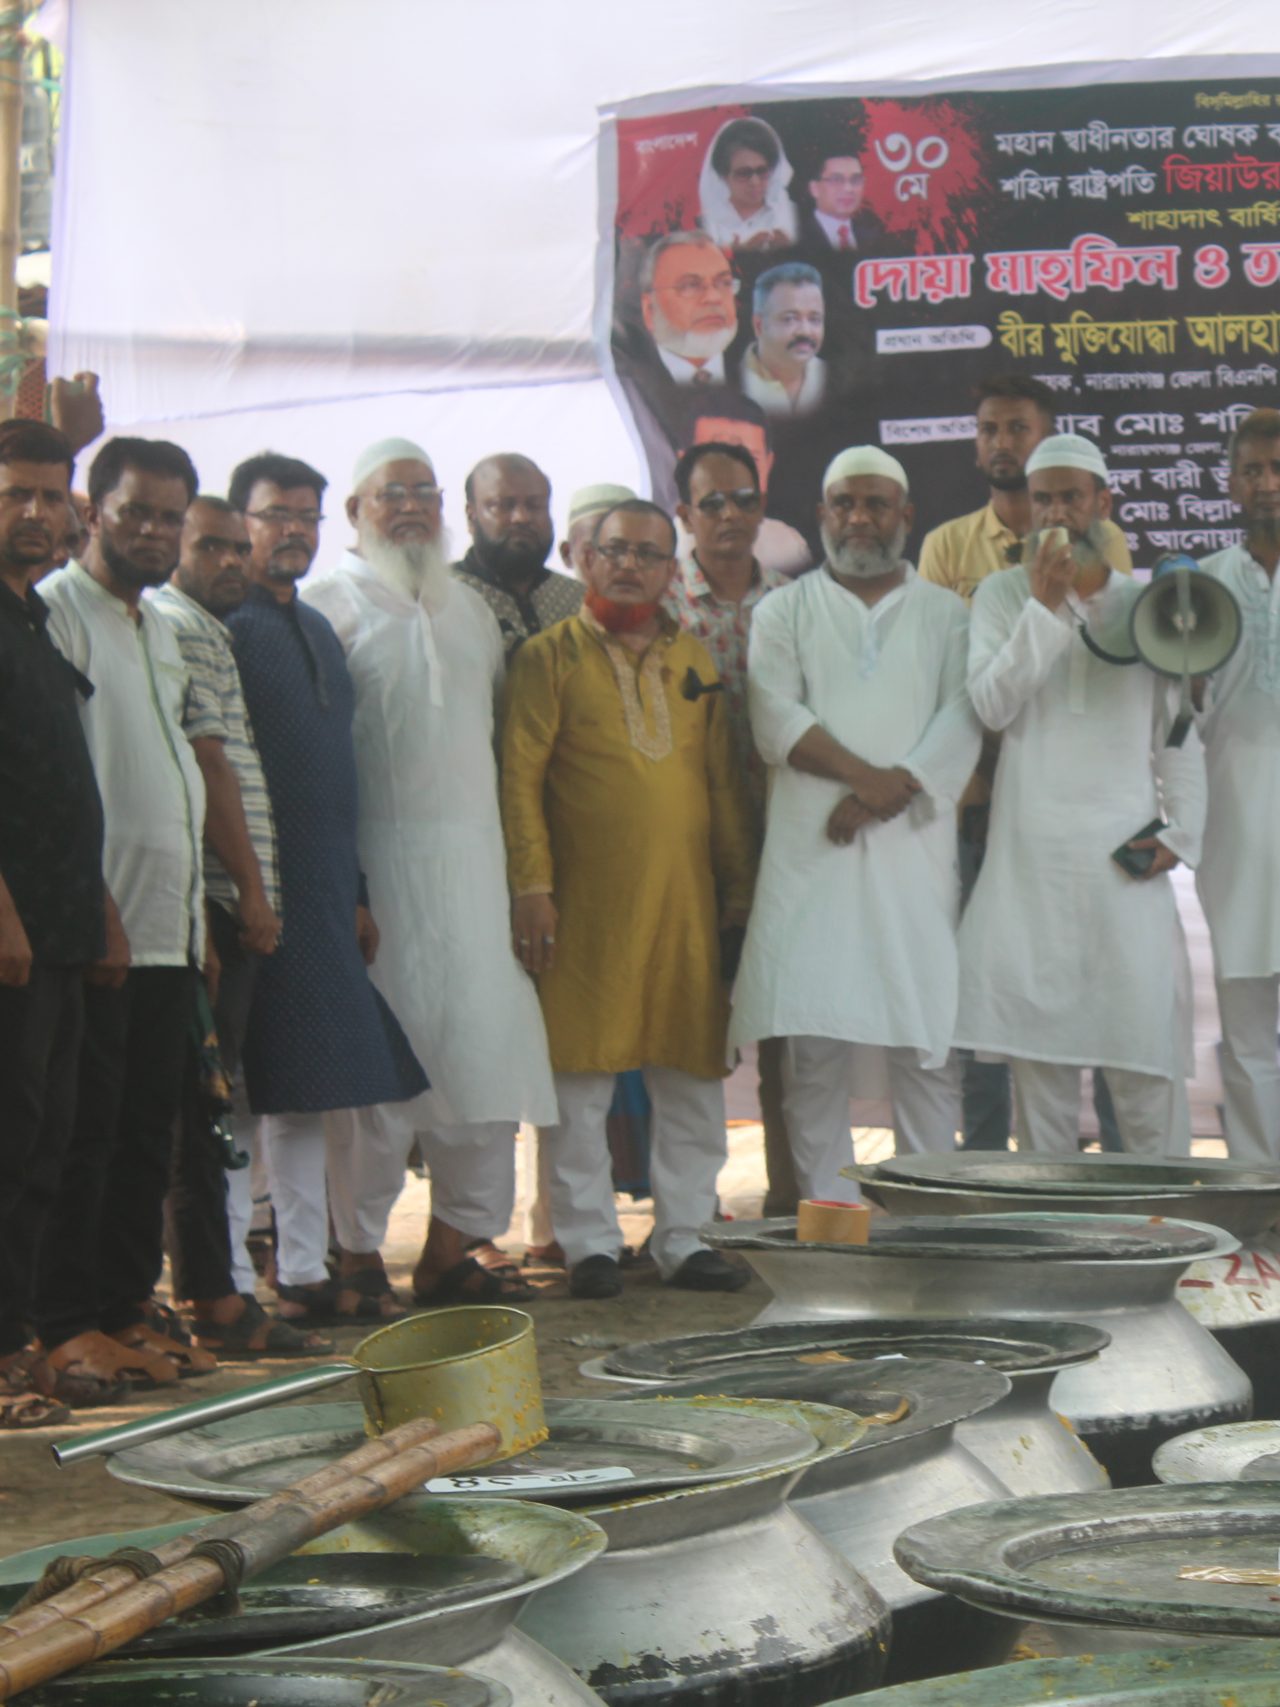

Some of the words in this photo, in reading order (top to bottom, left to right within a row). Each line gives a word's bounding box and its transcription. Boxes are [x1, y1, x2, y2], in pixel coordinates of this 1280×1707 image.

[874, 131, 950, 172] ৩০
[995, 132, 1056, 155] মহান
[1061, 120, 1175, 152] স্বাধীনতার
[1183, 124, 1259, 148] ঘোষক
[895, 173, 930, 202] মে
[999, 169, 1062, 200] শহিদ
[1067, 164, 1157, 200] রাষ্ট্রপতি
[1126, 207, 1222, 230] শাহাদাৎ
[855, 253, 975, 308] দোয়া
[984, 233, 1181, 300] মাহফিল
[1194, 244, 1231, 289] ও
[997, 311, 1046, 357] বীর
[1050, 310, 1178, 365] মুক্তিযোদ্ধা
[1170, 370, 1211, 388] জেলা
[1216, 364, 1277, 387] বিএনপি
[1115, 412, 1185, 436] মোঃ
[1150, 459, 1203, 490] বারী
[1119, 500, 1170, 522] মোঃ
